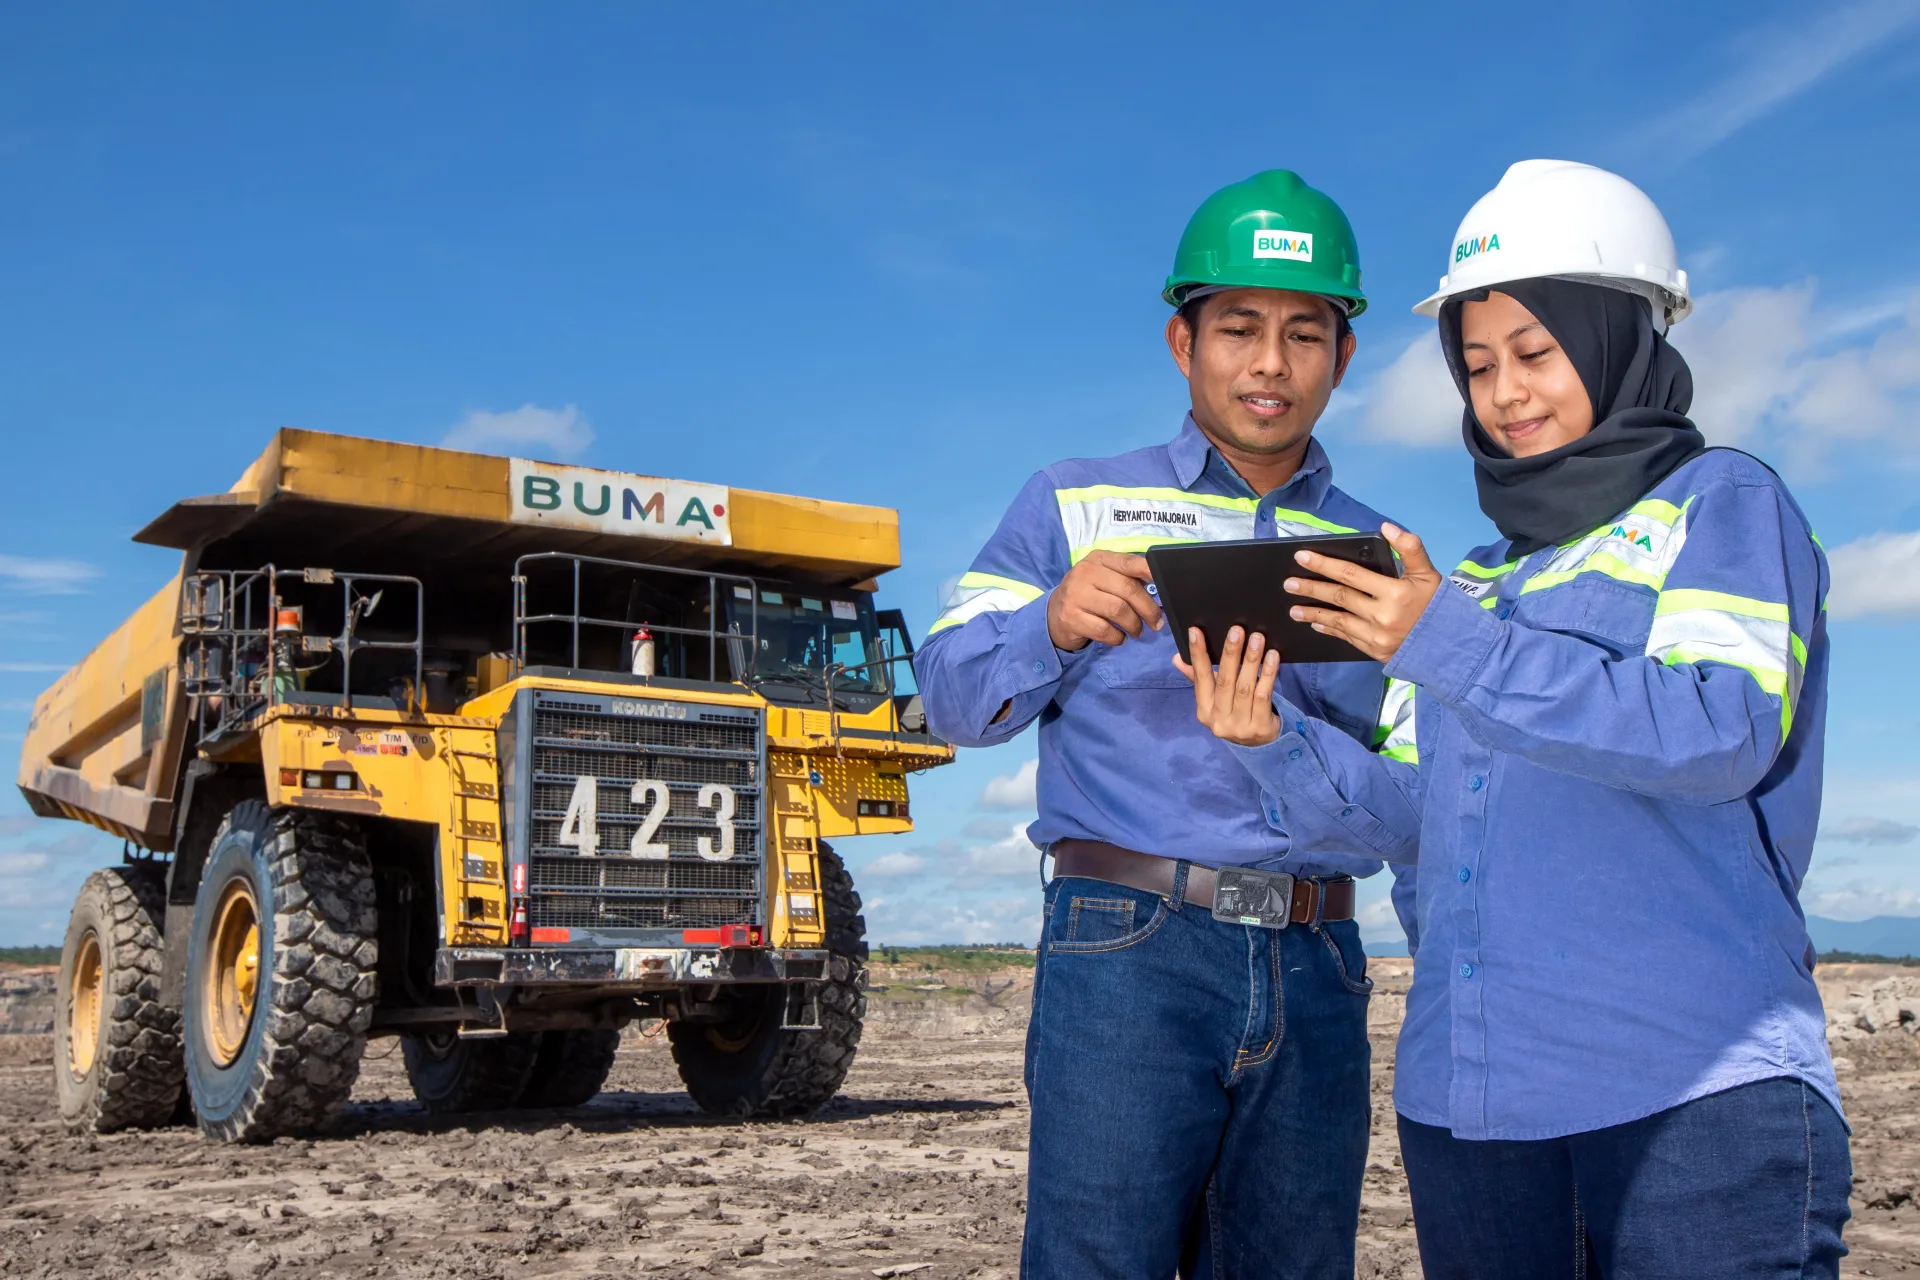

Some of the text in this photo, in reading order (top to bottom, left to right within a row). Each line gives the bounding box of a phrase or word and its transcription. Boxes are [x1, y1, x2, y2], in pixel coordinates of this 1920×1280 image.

[1258, 237, 1309, 254] BUMA
[1455, 233, 1500, 262] BUMA
[523, 475, 715, 530] BUMA
[1113, 509, 1197, 526] HERYANTO TANJORAYA
[612, 701, 687, 719] KOMATSU
[384, 733, 402, 743] T/M
[412, 734, 428, 744] F/D
